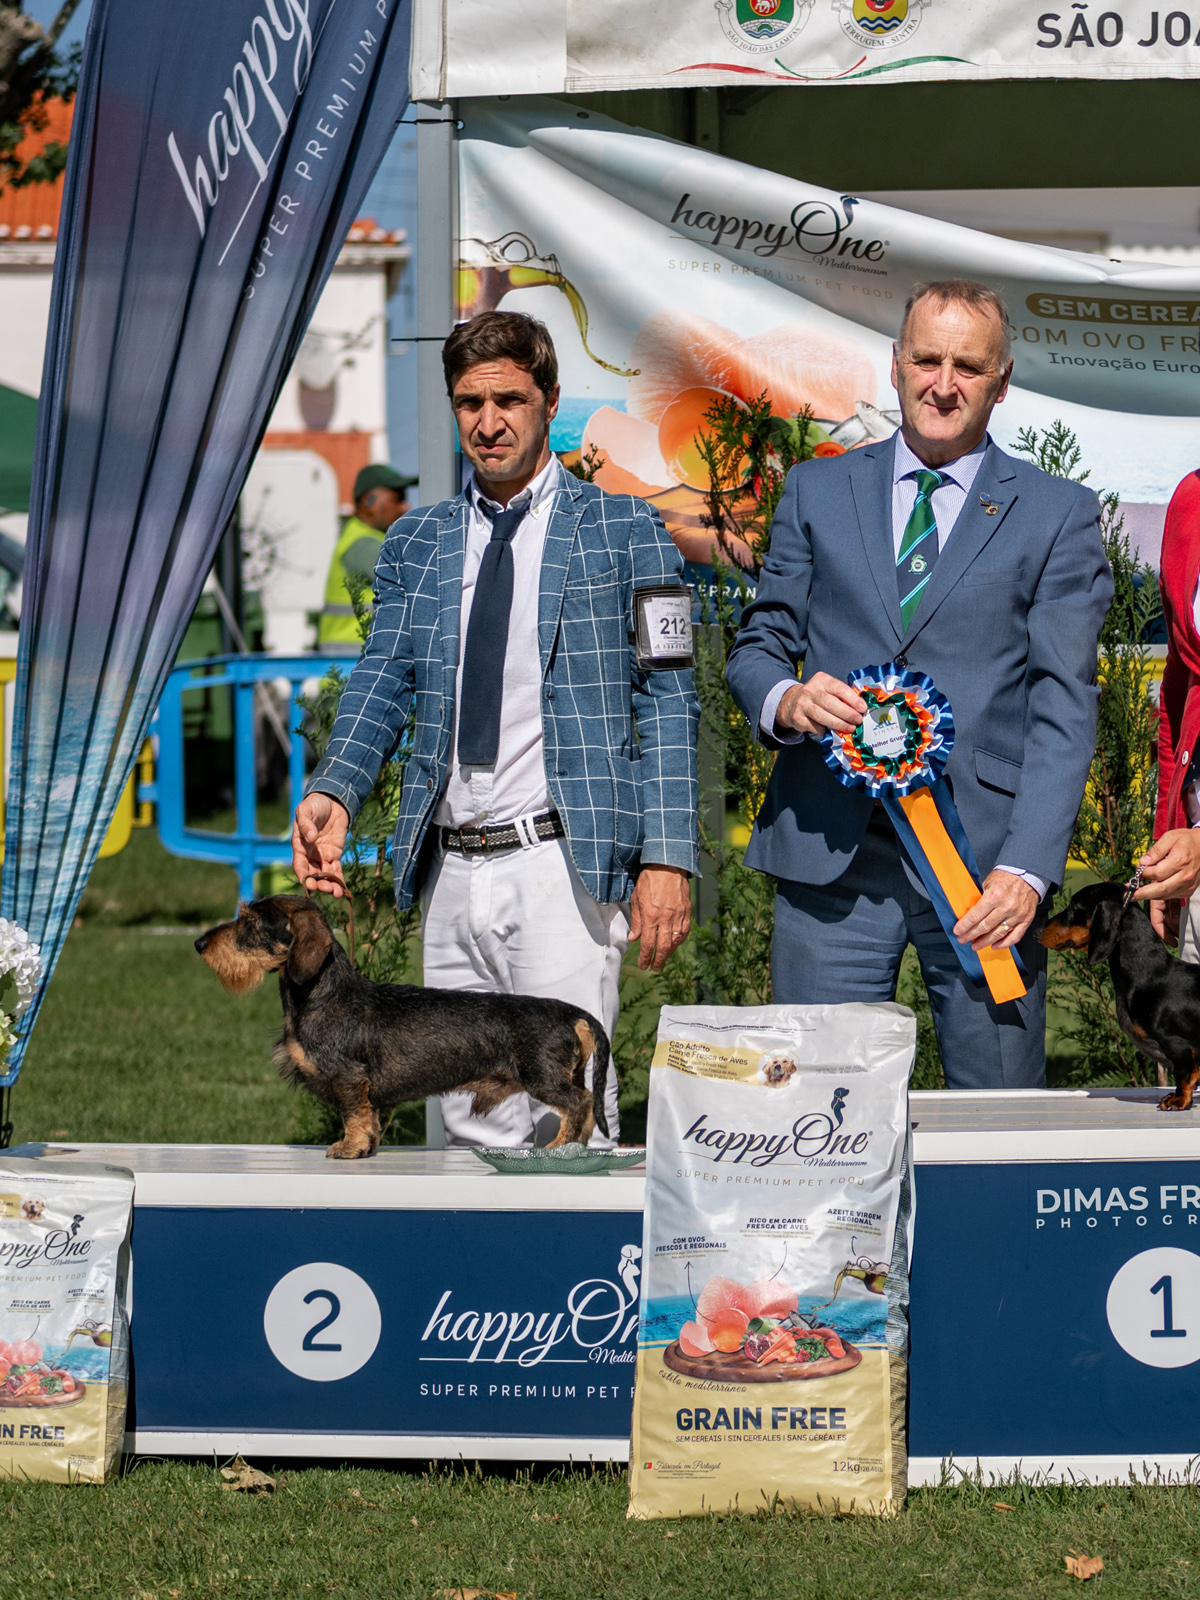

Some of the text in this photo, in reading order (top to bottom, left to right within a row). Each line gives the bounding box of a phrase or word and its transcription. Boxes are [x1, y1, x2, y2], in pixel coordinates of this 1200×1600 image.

[843, 18, 919, 47] TERRUGEM SINTRA
[1036, 2, 1124, 48] SÃO
[726, 29, 739, 45] SÃO
[759, 44, 774, 52] DAS
[774, 26, 802, 49] LAMPAS
[246, 29, 378, 299] SUPER PREMIUM
[670, 193, 886, 262] happyOne
[812, 253, 889, 277] Mediterraneum
[668, 259, 893, 300] SUPER PREMIUM PET FOOD
[1037, 298, 1100, 319] SEM
[1082, 331, 1146, 351] OVO
[1160, 335, 1200, 353] FR
[1048, 352, 1200, 374] Inovação Euro
[659, 617, 687, 635] 212
[873, 724, 899, 737] SINTRA
[889, 734, 908, 743] Grupo
[668, 1046, 748, 1066] Carne Fresca de Aves
[669, 1040, 711, 1053] Cão Adulto
[682, 1112, 869, 1168] happyOne
[803, 1156, 868, 1168] Mediterraneum
[676, 1169, 865, 1187] SUPER PREMIUM PET FOOD
[1036, 1185, 1149, 1214] DIMAS
[781, 1217, 807, 1225] CARNE
[827, 1208, 882, 1220] AZEITE VIRGEM
[836, 1214, 873, 1226] REGIONAL
[0, 1229, 92, 1269] ppyOne
[655, 1244, 683, 1253] FRESCOS
[689, 1242, 727, 1250] REGIONAIS
[672, 1237, 687, 1245] COM
[46, 1274, 62, 1282] PET
[65, 1272, 87, 1281] FOOD
[1149, 1275, 1187, 1338] 1
[301, 1288, 343, 1353] 2
[421, 1278, 639, 1368] happyOn
[588, 1347, 636, 1365] Medite
[658, 1367, 748, 1393] estilo mediterrâneo
[420, 1383, 620, 1399] SUPER PREMIUM PET
[676, 1406, 847, 1432] GRAIN FREE
[19, 1425, 66, 1440] FREE
[675, 1432, 847, 1443] SEM CEREAIS SIN CEREALES SANS CÉRÉALES
[692, 1460, 721, 1472] Portugal
[832, 1461, 860, 1474] 12kg
